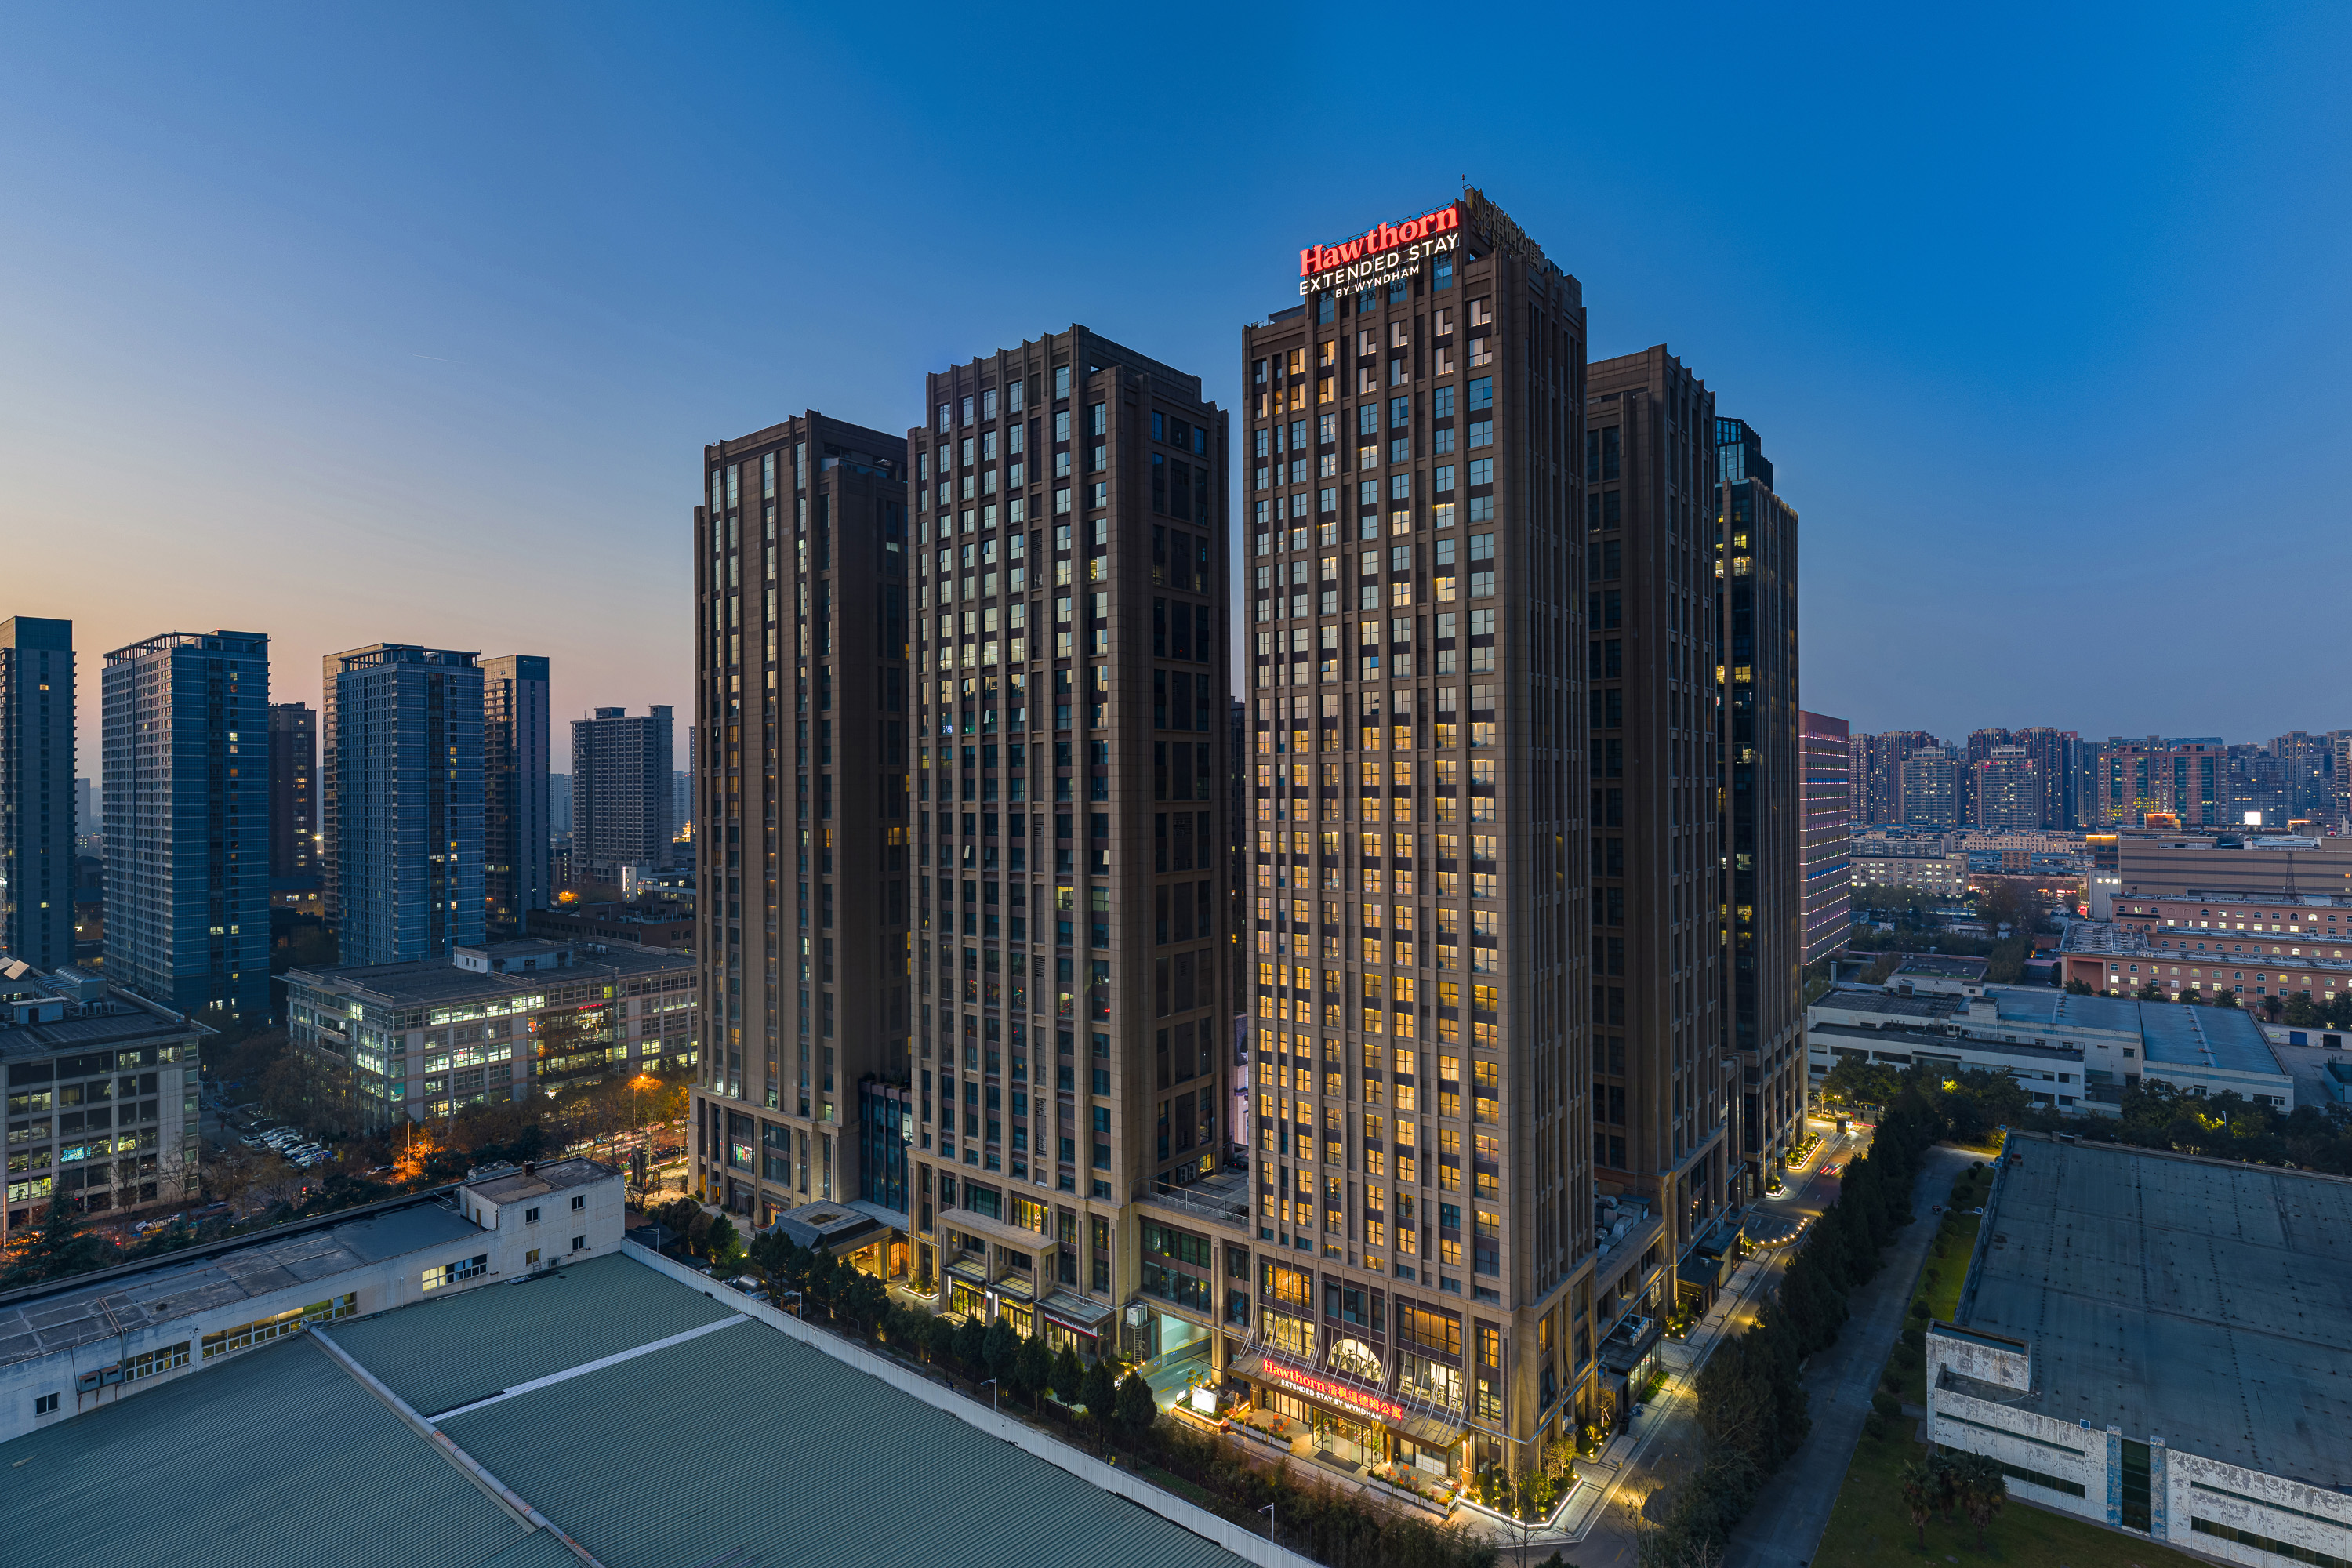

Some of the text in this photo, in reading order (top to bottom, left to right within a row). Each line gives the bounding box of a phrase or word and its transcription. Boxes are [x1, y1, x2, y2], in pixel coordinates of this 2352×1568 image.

[1299, 207, 1459, 277] Hawthorn
[1299, 252, 1399, 296] EXTENDED
[1409, 232, 1459, 261] STAY
[1335, 264, 1419, 298] BY WYNDHAM
[1263, 1359, 1403, 1420] Hawthorn 浩枫温德姆公寓
[1281, 1378, 1382, 1421] EXTENDED STAY BY WYNDHAM
